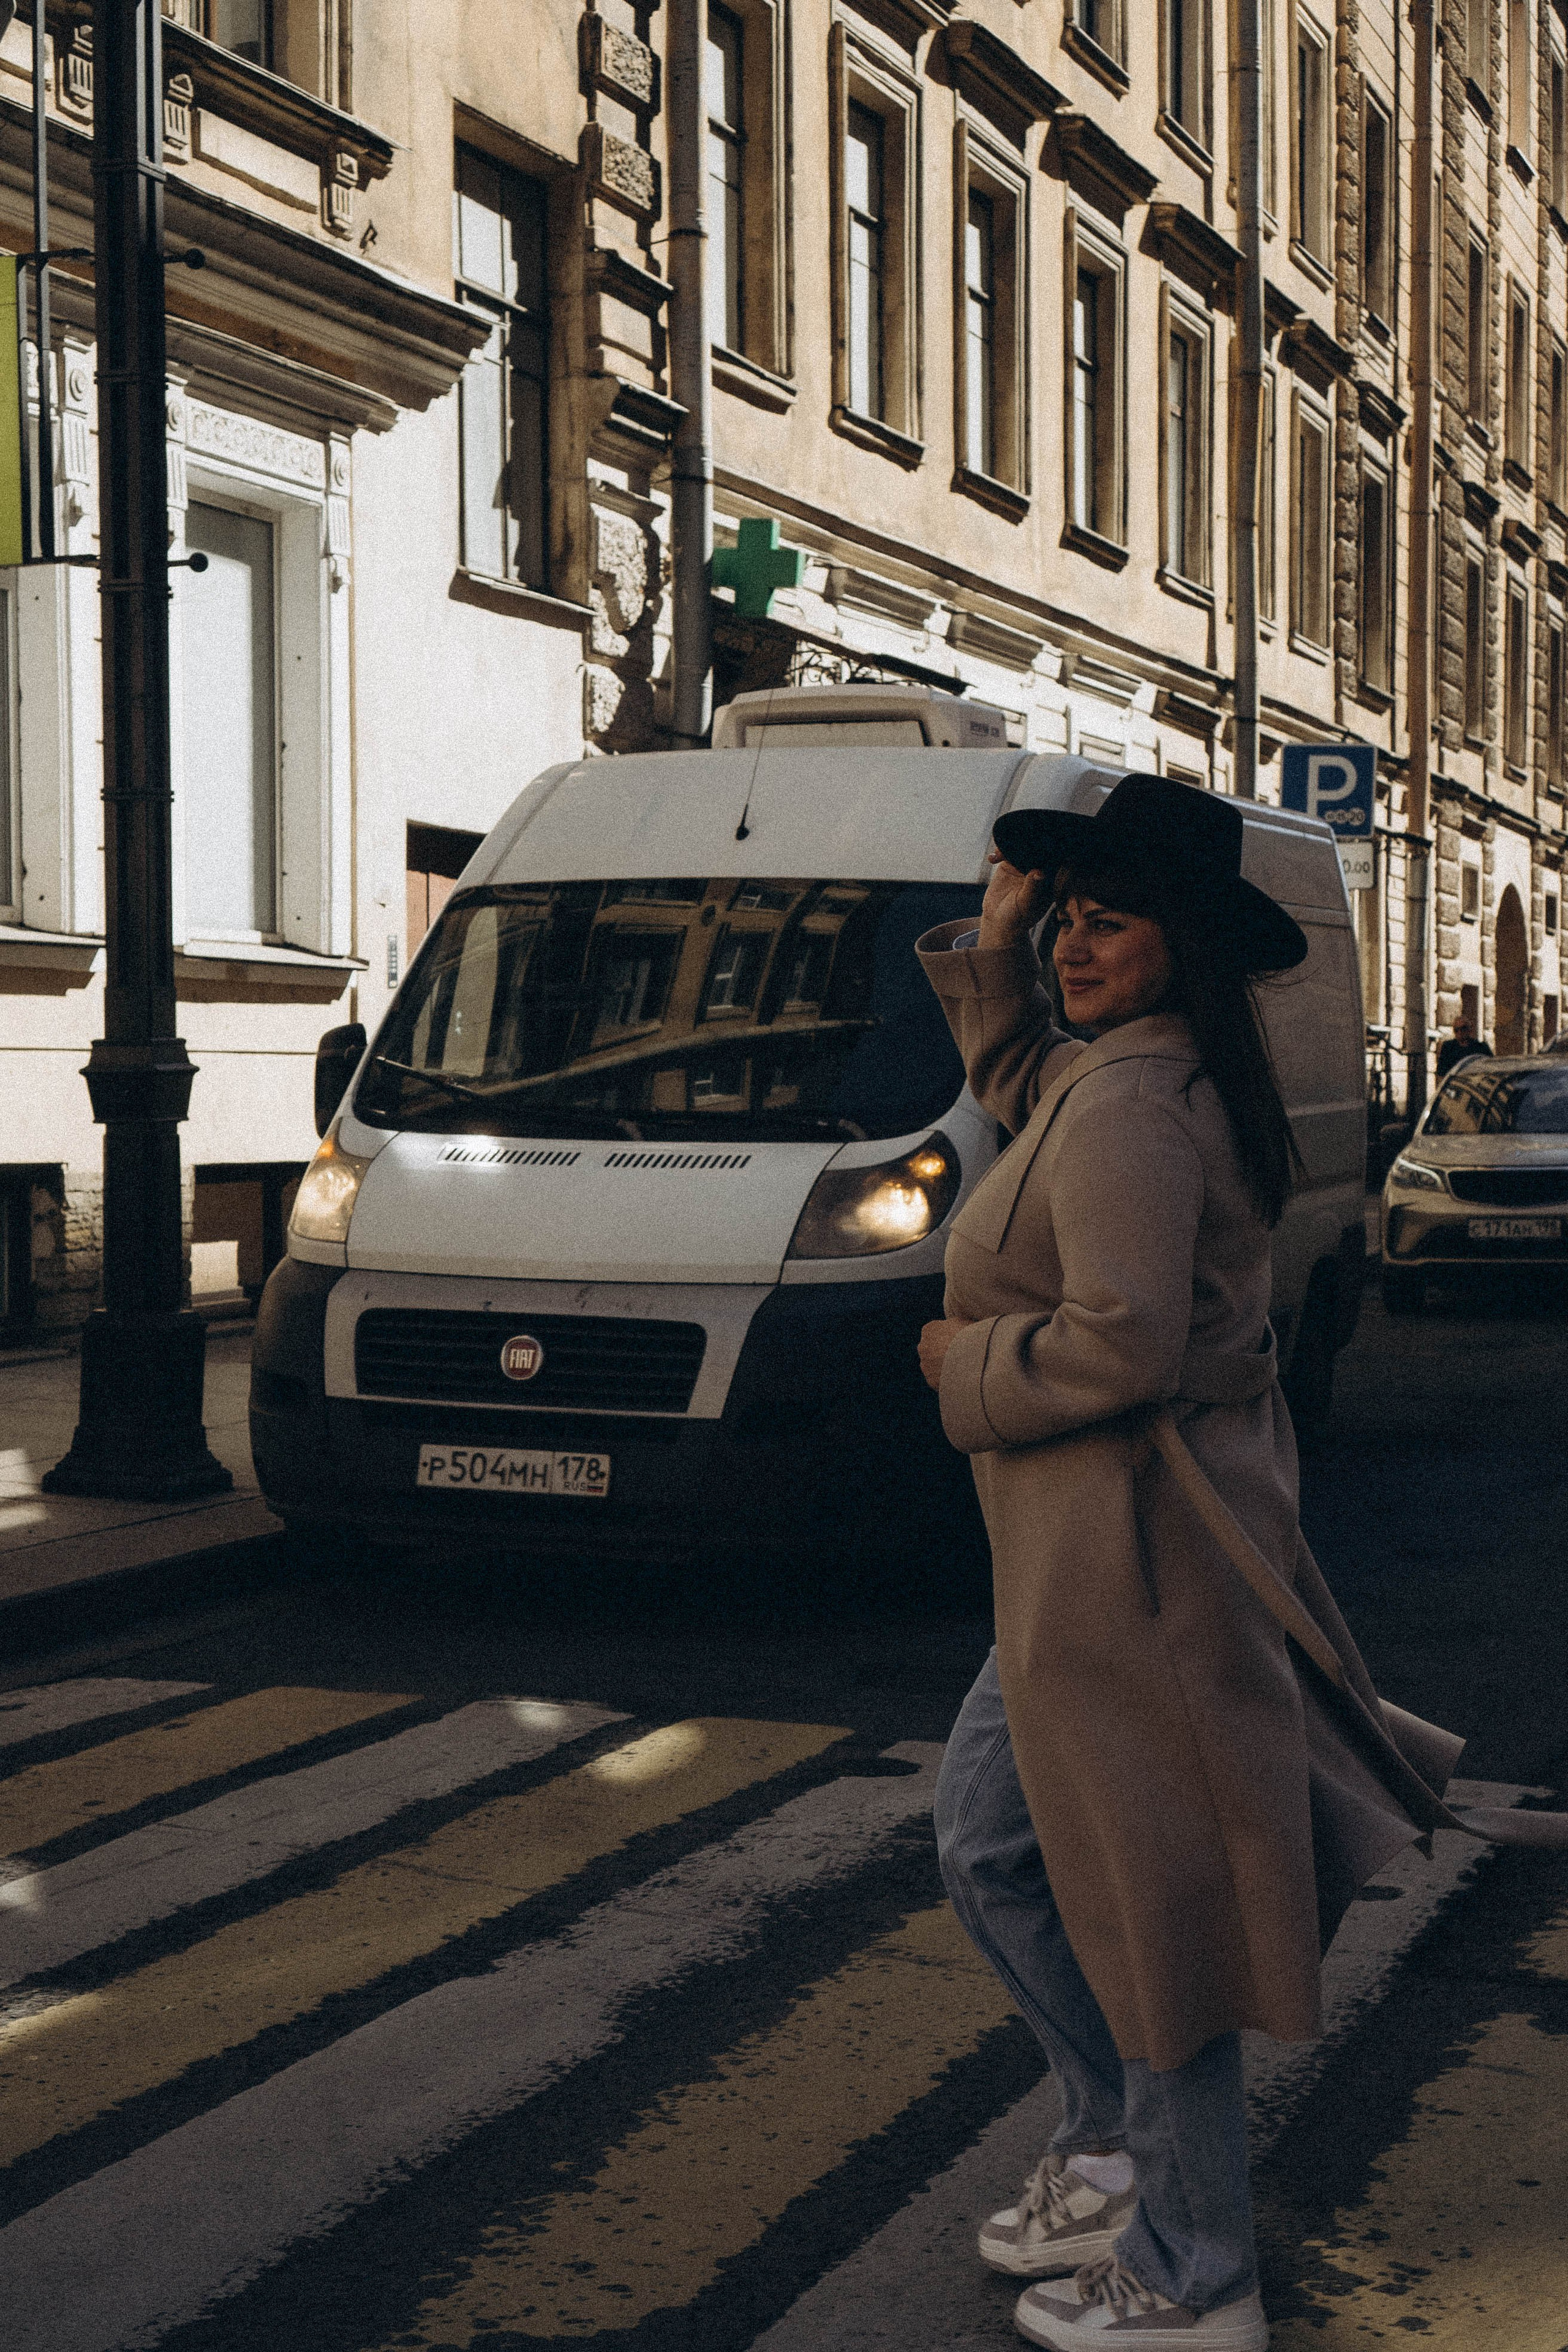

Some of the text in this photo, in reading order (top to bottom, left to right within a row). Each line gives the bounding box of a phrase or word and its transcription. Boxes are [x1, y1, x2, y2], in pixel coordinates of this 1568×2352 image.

[1306, 755, 1357, 818] P
[509, 1349, 535, 1368] FIAT
[557, 1456, 601, 1481] 178
[563, 1482, 587, 1492] RUS
